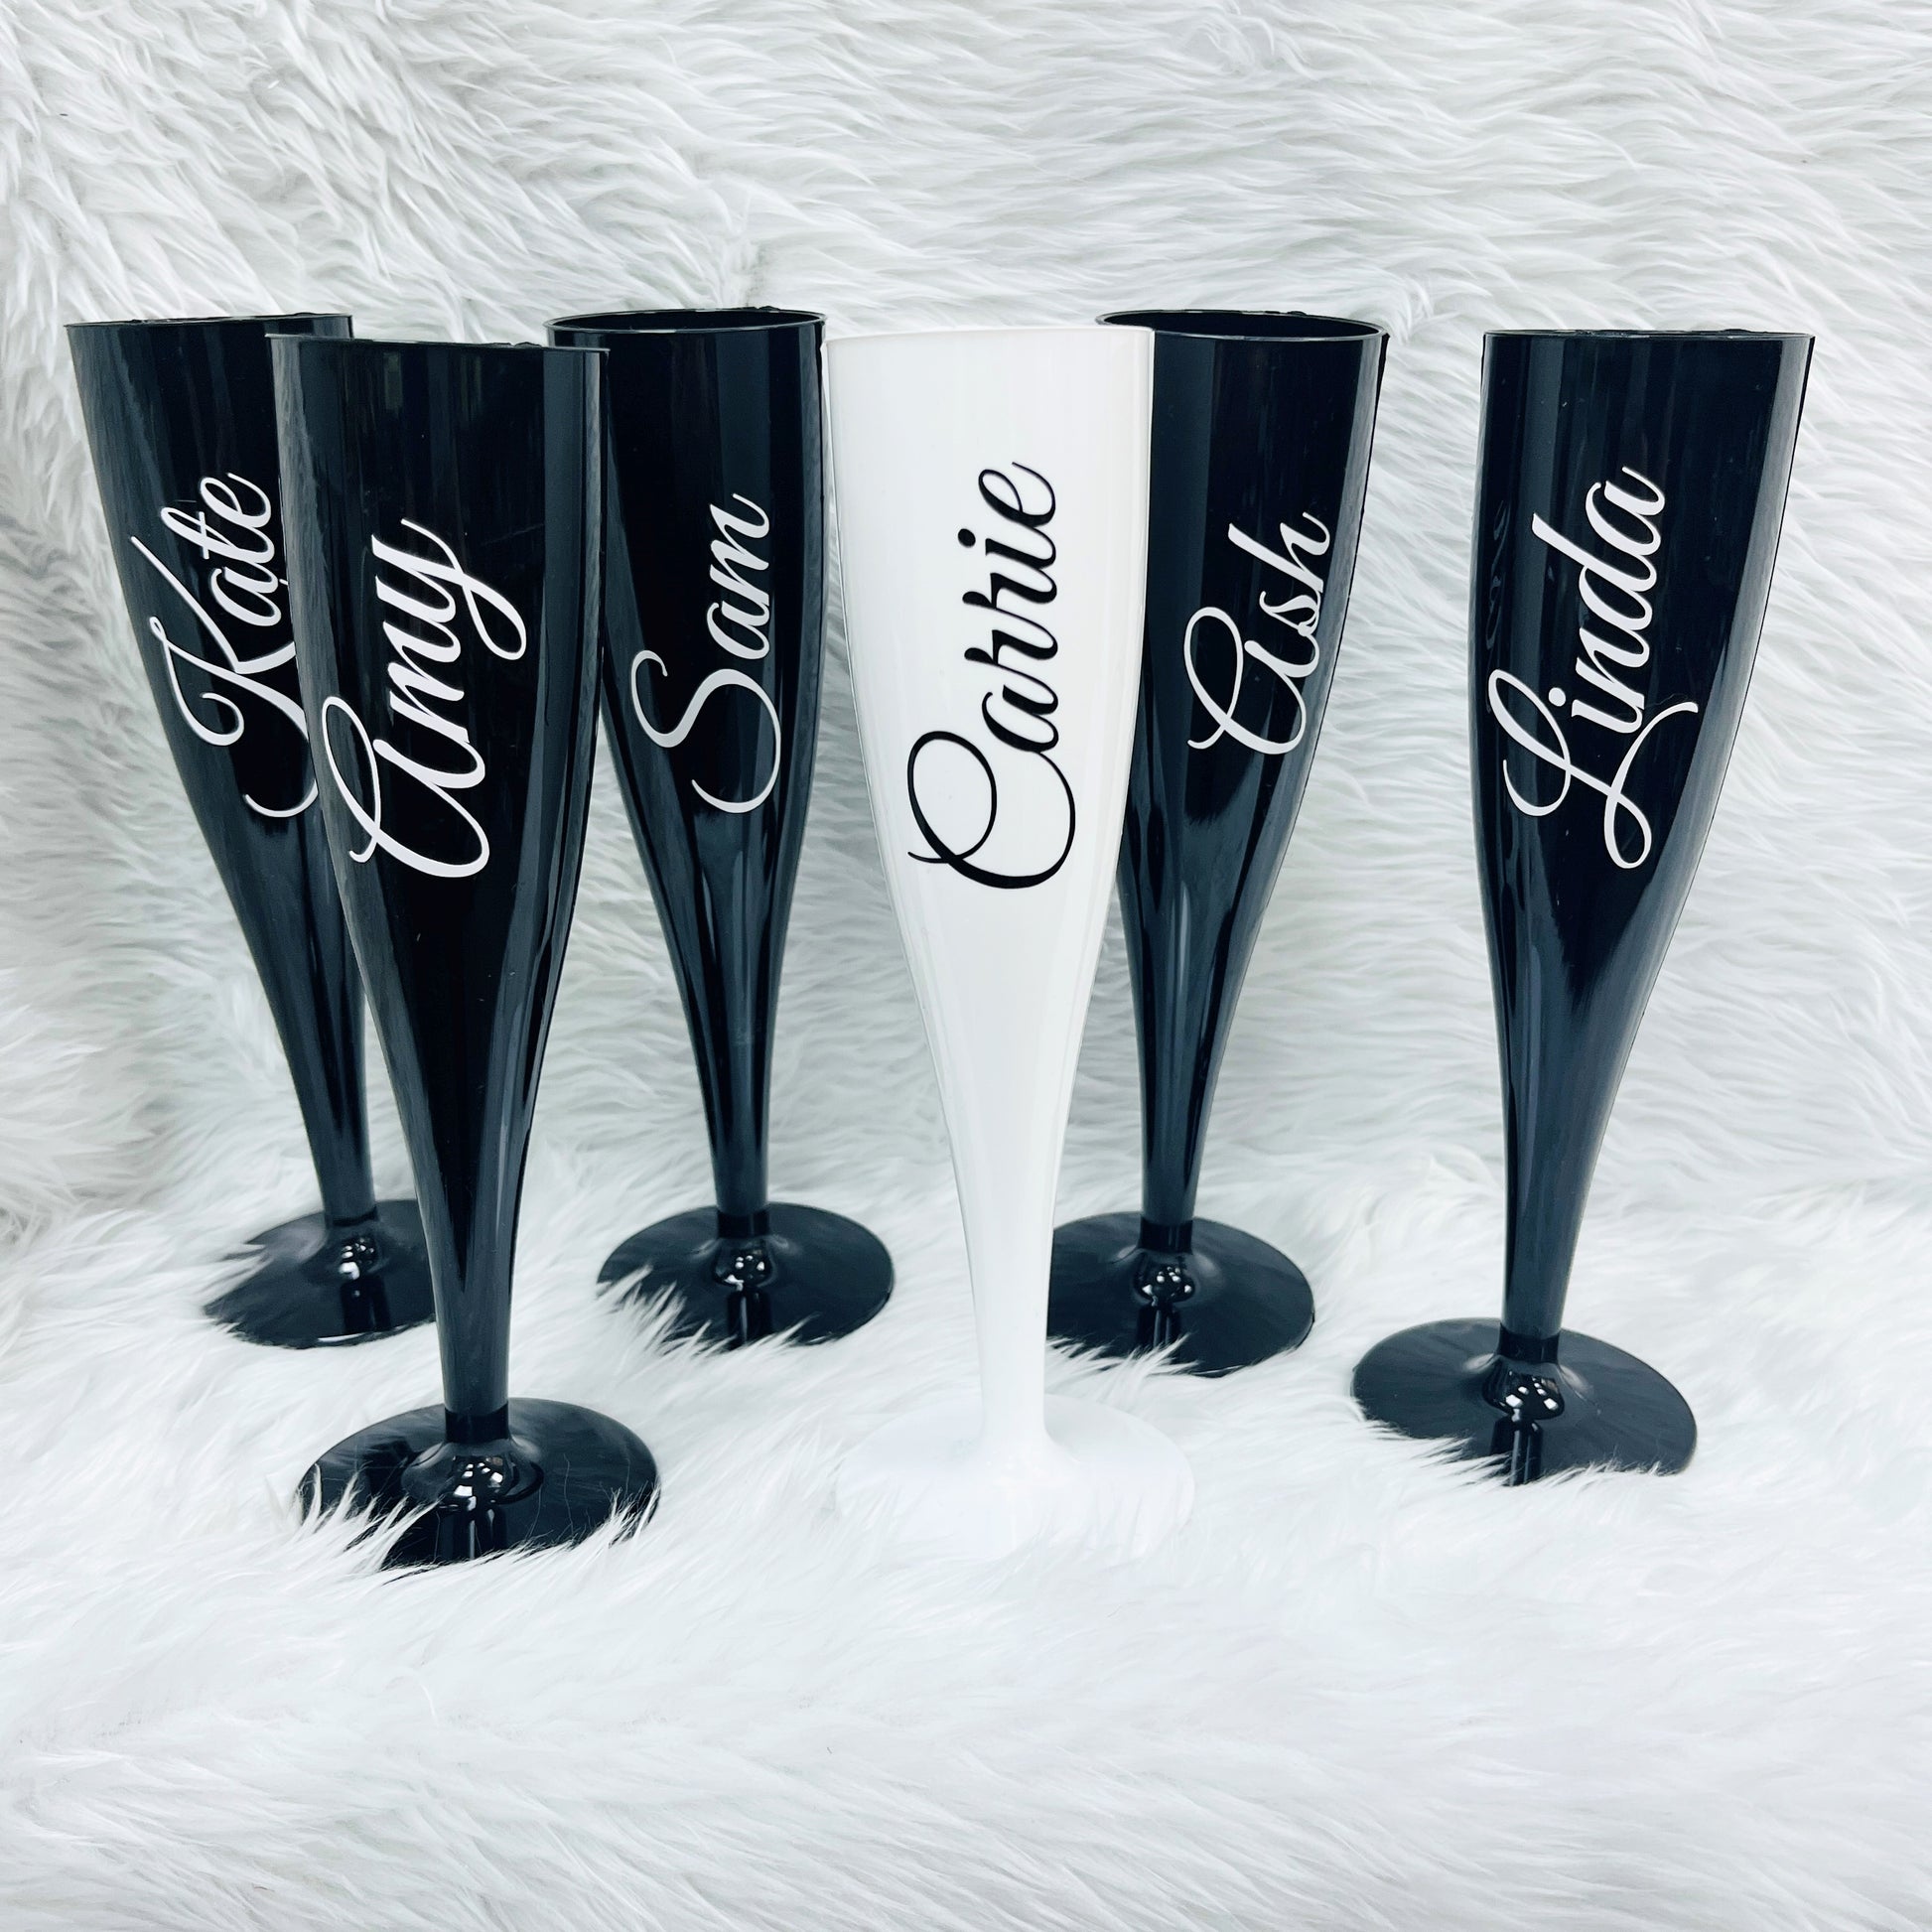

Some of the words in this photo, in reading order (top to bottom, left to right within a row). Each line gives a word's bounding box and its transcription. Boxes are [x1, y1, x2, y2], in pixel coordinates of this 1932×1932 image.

[130, 472, 319, 818] Kate
[321, 518, 527, 879] Amy
[629, 492, 781, 814] Sam
[907, 461, 1076, 890] Carrie
[1183, 511, 1331, 755] Ash
[1487, 467, 1699, 869] Linda
